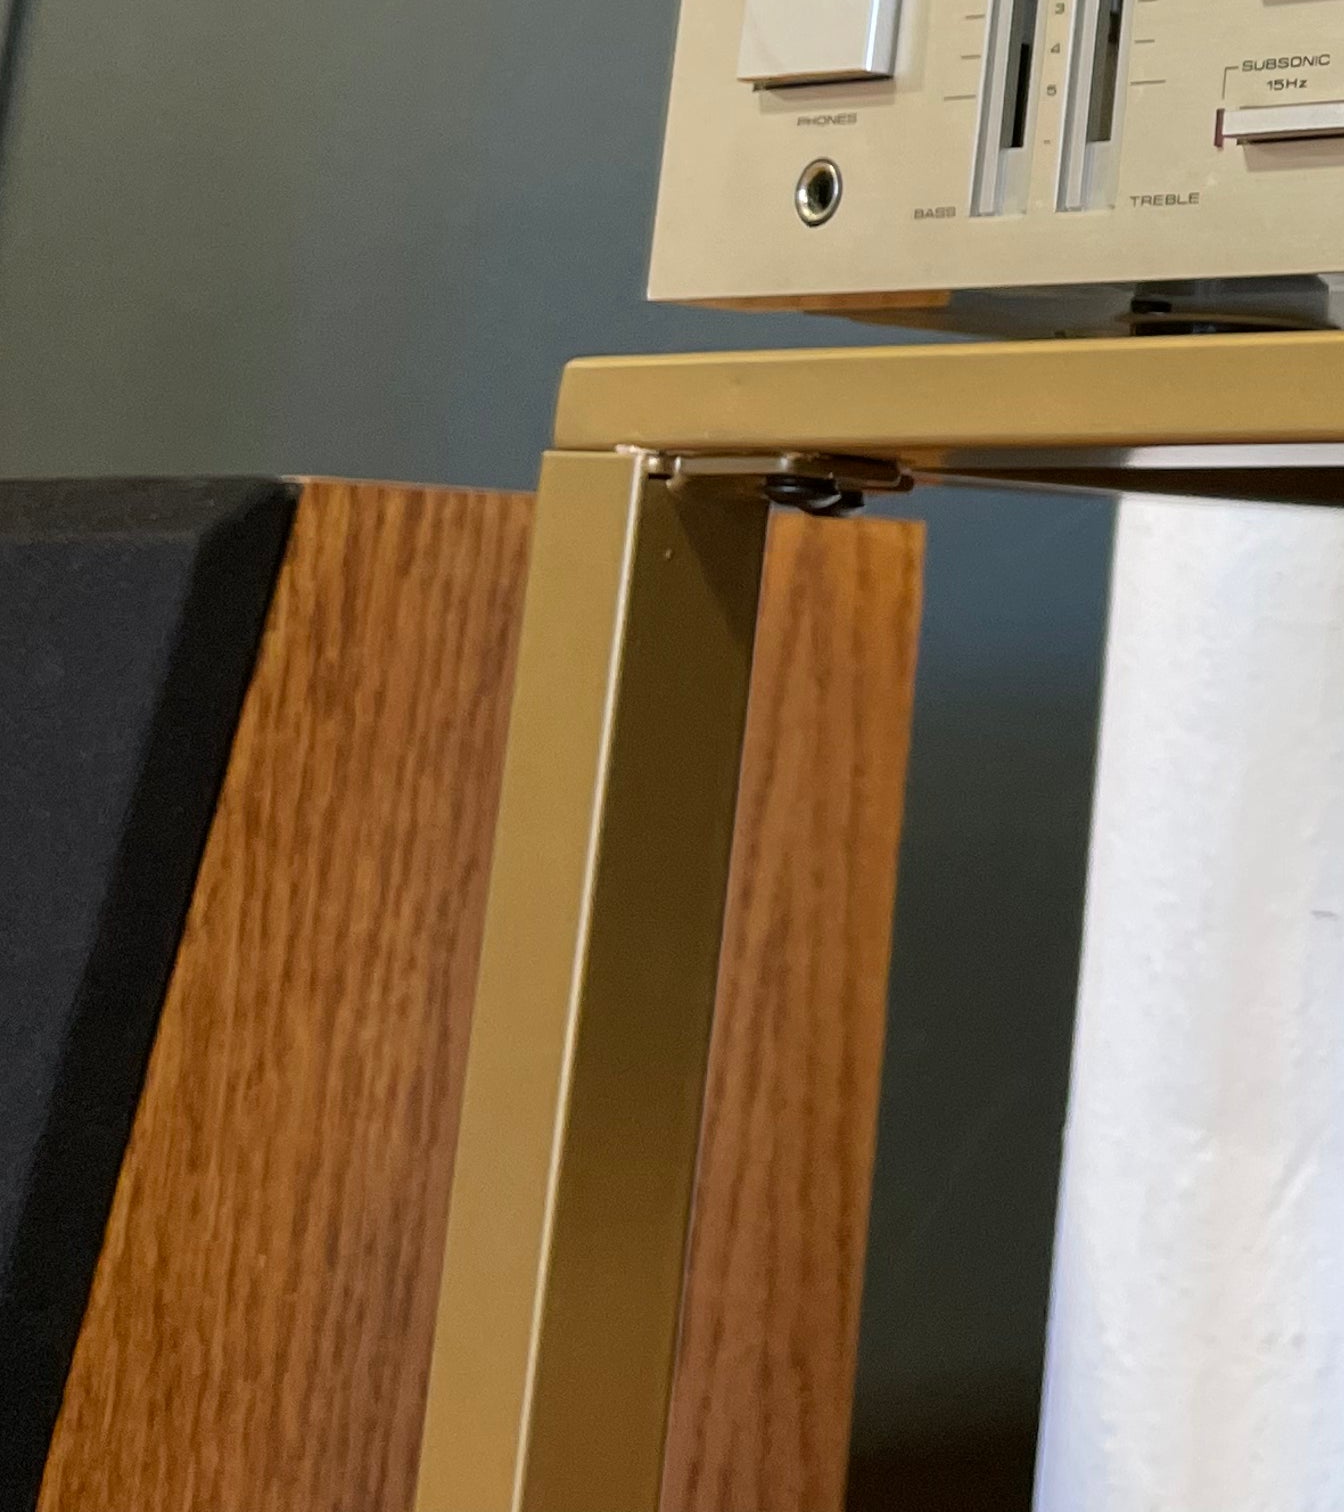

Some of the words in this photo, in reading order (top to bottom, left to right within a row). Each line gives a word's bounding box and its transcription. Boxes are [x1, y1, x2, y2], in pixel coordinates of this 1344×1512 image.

[1242, 55, 1331, 73] SUBSONIC
[1266, 77, 1308, 90] 15Hz
[796, 112, 857, 127] PHONES
[1130, 192, 1199, 207] TREBLE
[913, 206, 957, 220] BASS
